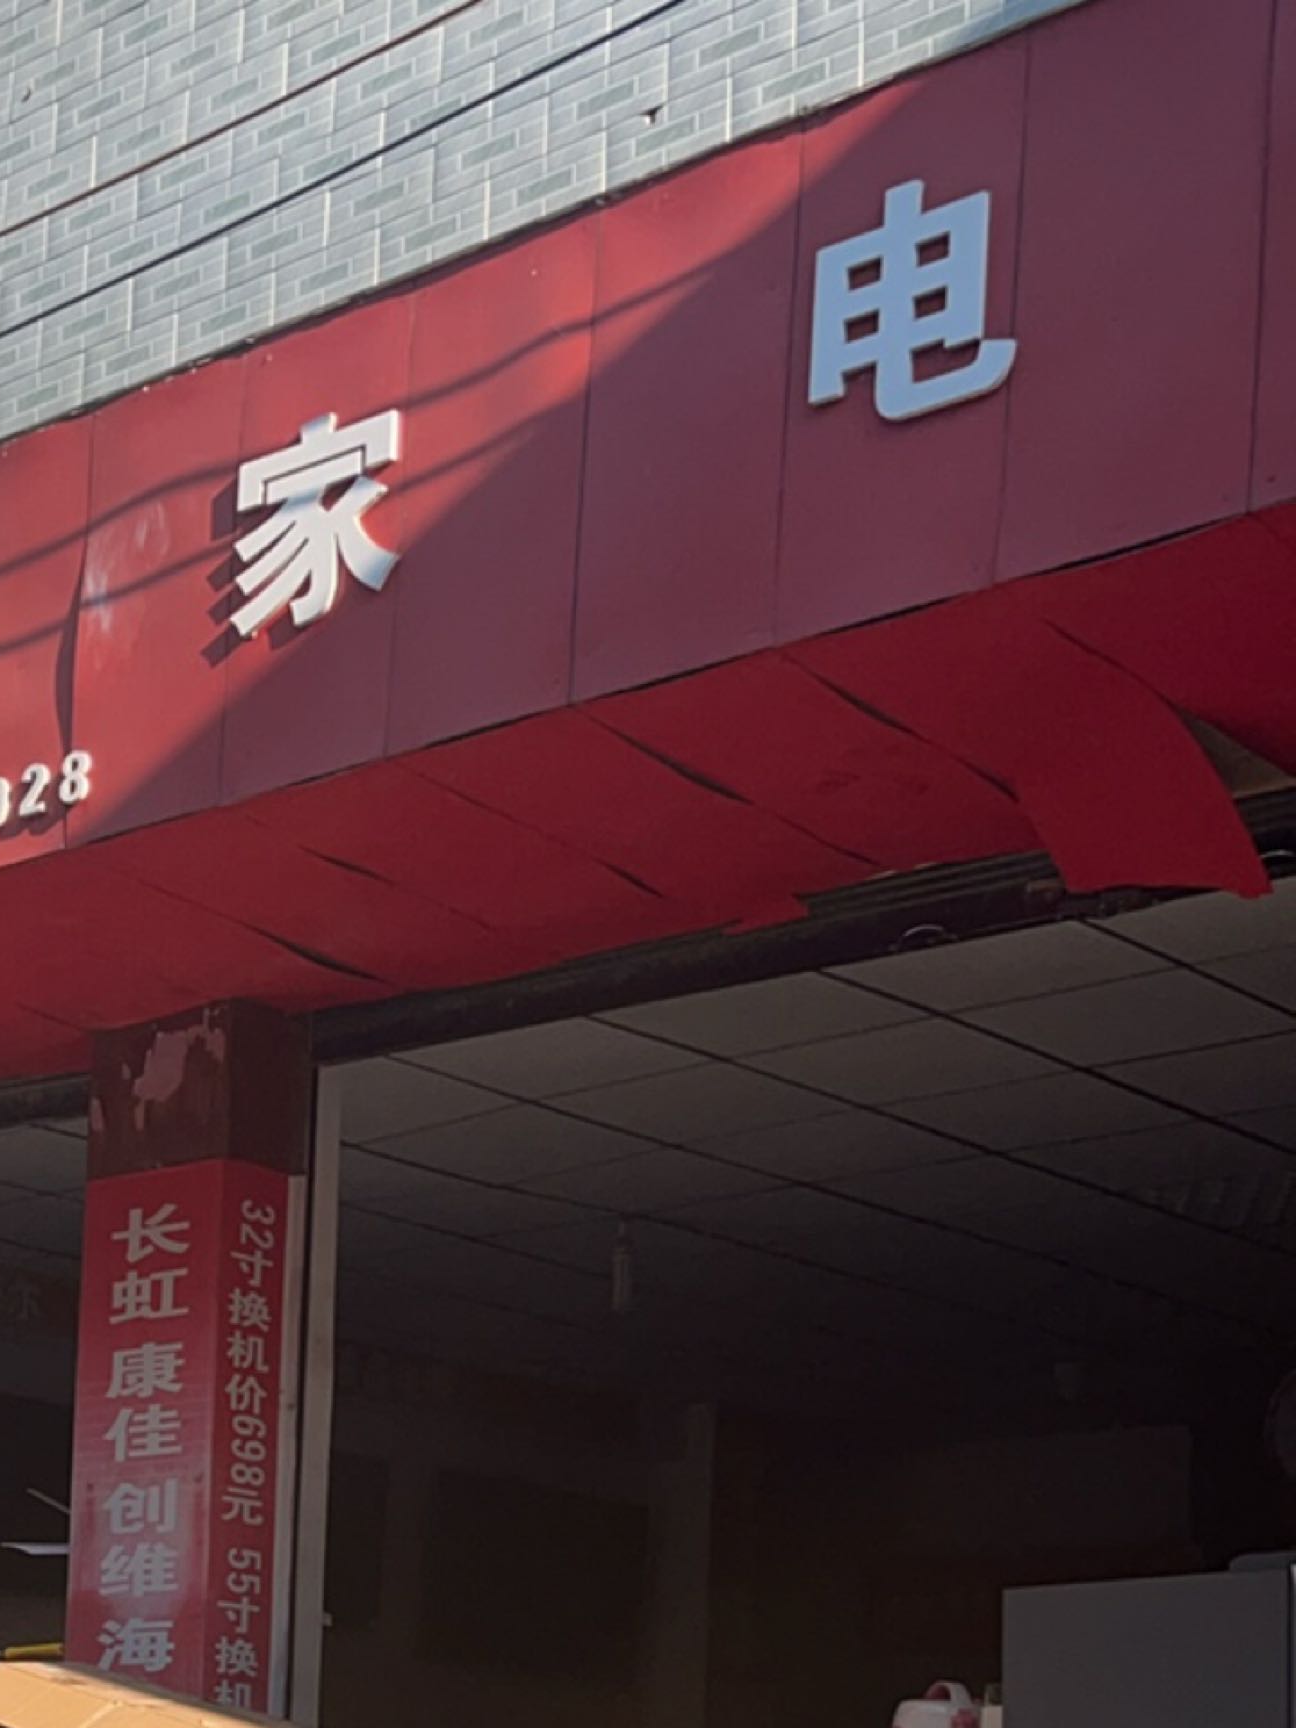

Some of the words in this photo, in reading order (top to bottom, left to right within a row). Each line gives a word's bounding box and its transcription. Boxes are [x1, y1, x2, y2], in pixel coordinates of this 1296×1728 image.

[97, 1203, 190, 1673] 长虹康佳创维海
